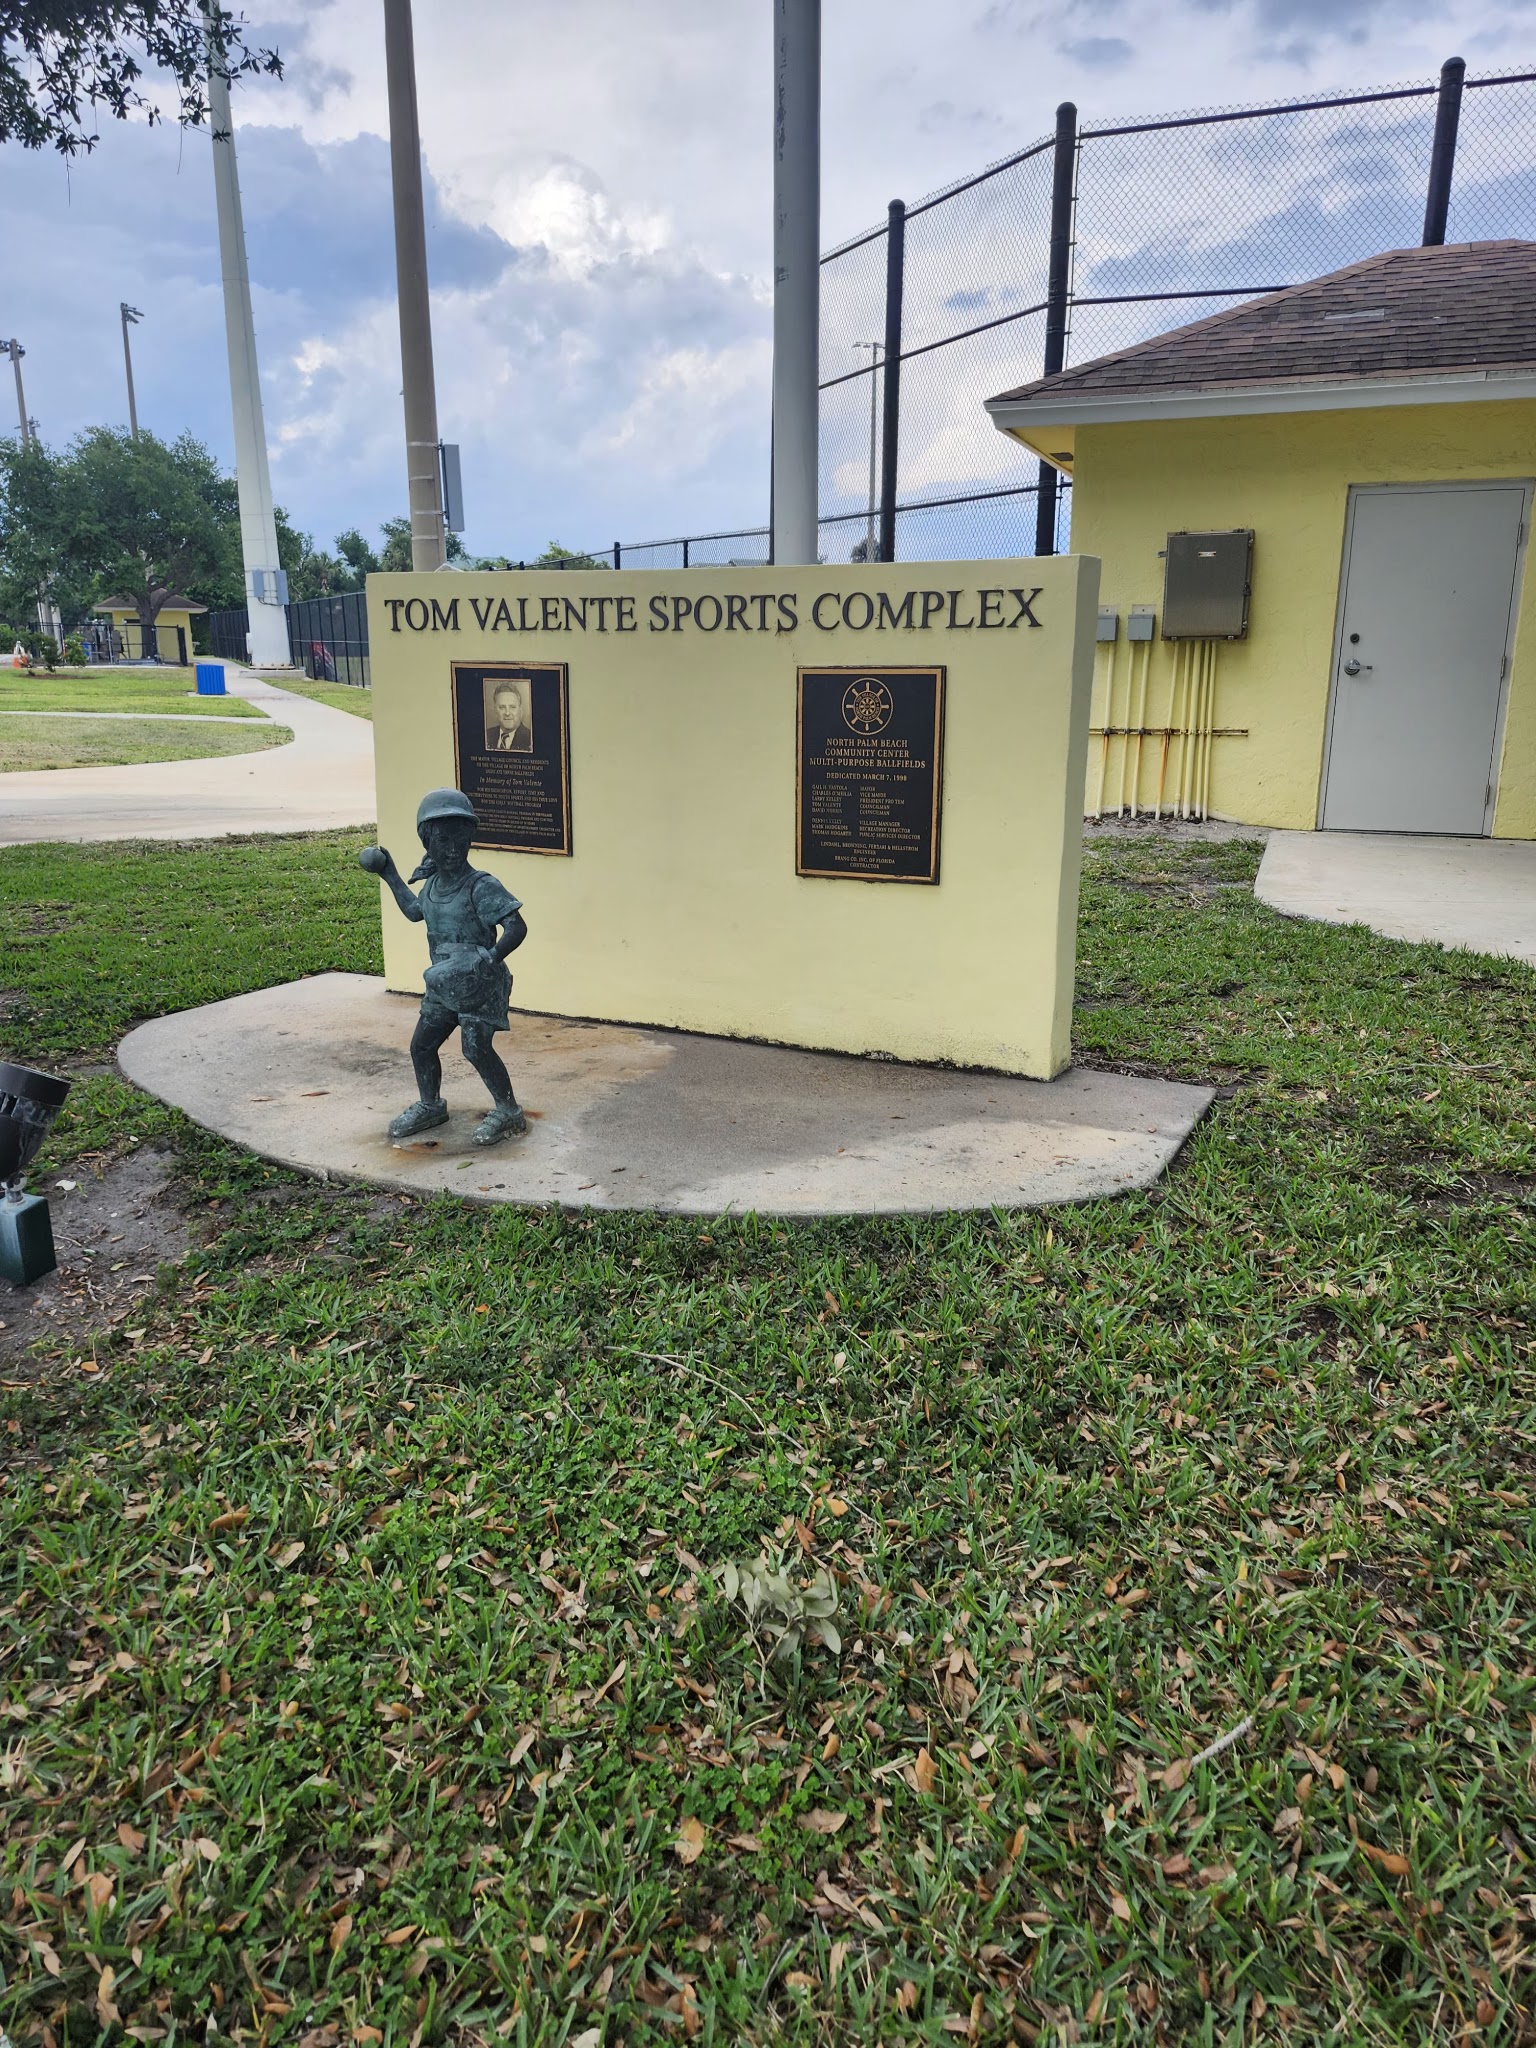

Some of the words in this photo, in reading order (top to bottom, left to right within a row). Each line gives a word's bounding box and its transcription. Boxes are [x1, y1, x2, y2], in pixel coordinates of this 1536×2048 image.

[384, 598, 462, 632] TOM
[468, 597, 638, 632] VALENTE
[649, 594, 798, 632] SPORTS
[812, 588, 1044, 631] COMPLEX
[826, 738, 855, 747] NORTH
[857, 739, 878, 747] PALM
[880, 739, 908, 748] BEACH
[825, 748, 876, 757] COMMUNITY
[877, 749, 909, 758] CENTER
[809, 757, 874, 767] MULTI-PURPOSE
[877, 759, 926, 769] BALLFIELDS
[826, 772, 861, 780] DEDICATED
